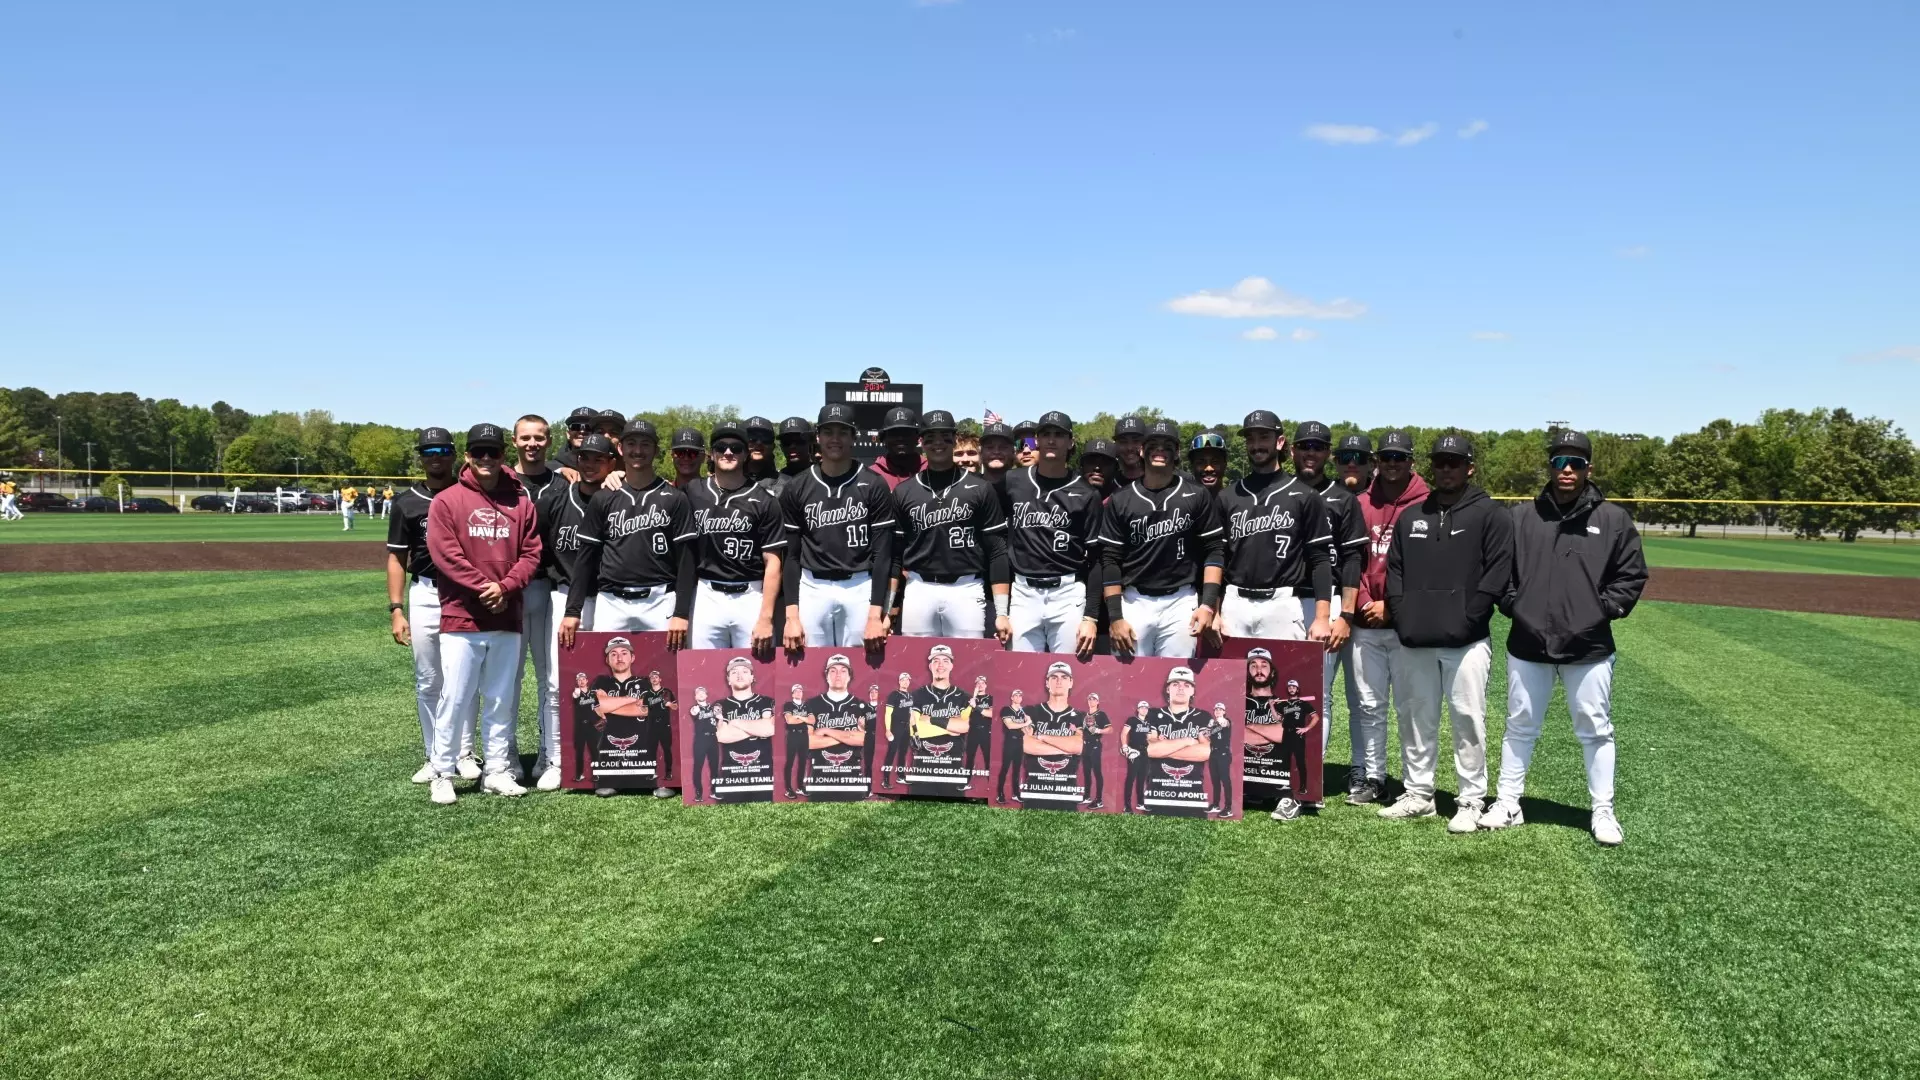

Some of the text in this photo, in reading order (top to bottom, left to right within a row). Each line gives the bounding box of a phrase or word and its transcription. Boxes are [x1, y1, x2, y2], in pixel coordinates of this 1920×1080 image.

[846, 392, 903, 402] HAWK STADIUM
[608, 504, 670, 540] Hawks
[694, 508, 752, 537] Hawks
[805, 497, 868, 531] Hawks
[910, 498, 973, 531] Hawks
[1013, 502, 1071, 529] Hawks
[1230, 505, 1294, 542] Hawks
[469, 526, 509, 538] HAWKS
[847, 524, 868, 547] 11
[949, 526, 974, 548] 27
[1130, 508, 1194, 545] Hawks
[653, 533, 668, 554] 8
[724, 537, 753, 560] 37
[1053, 530, 1070, 552] 2
[1177, 538, 1185, 559] 1
[1275, 535, 1290, 558] 7
[1260, 769, 1290, 777] CARSON
